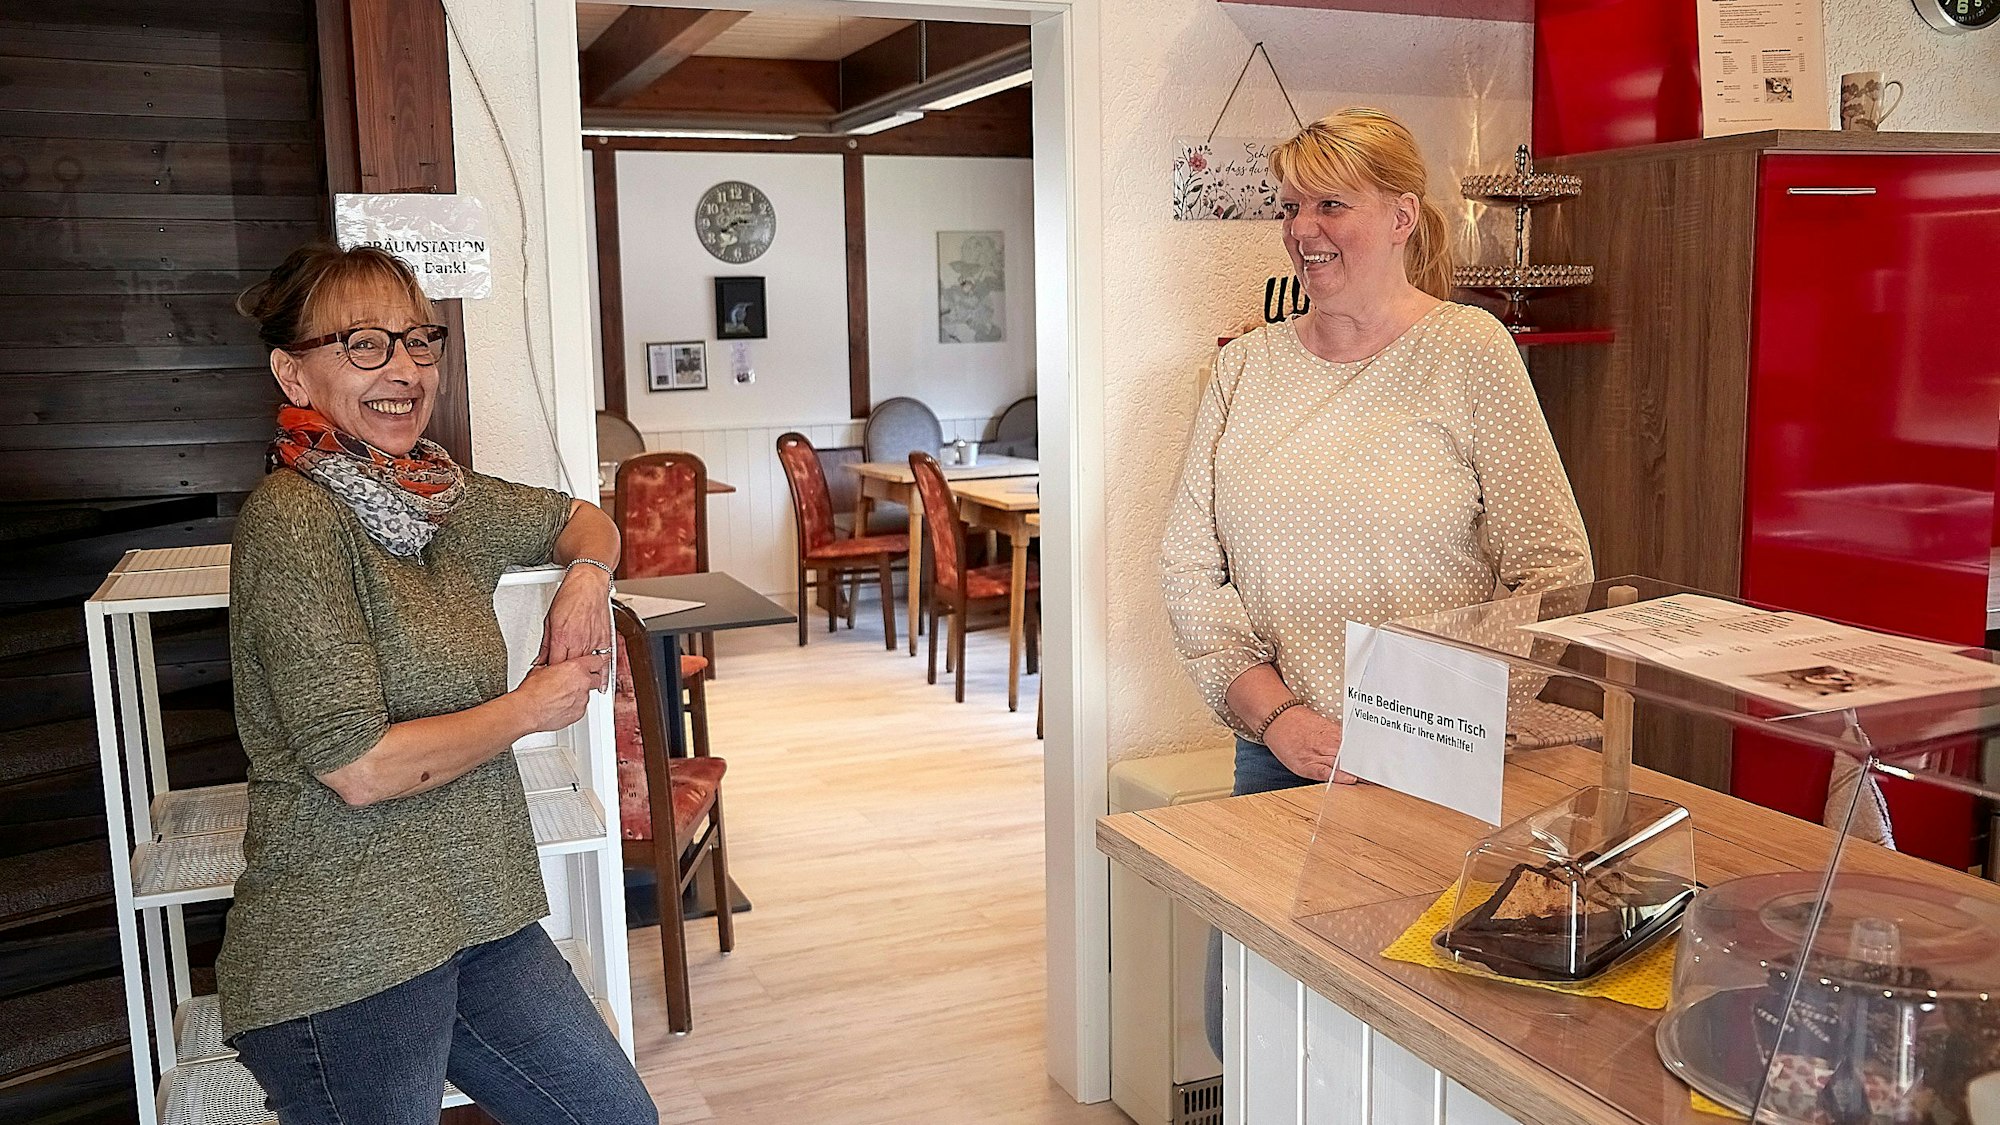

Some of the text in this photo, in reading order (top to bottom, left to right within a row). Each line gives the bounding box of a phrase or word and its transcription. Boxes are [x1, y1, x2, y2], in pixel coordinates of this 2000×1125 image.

[1225, 160, 1245, 176] dass
[357, 238, 485, 253] RÄUMSTATION
[425, 261, 466, 274] Dank!
[1376, 694, 1434, 726] Bedienung
[1437, 715, 1454, 729] am
[1457, 717, 1486, 739] Tisch
[1354, 708, 1474, 753] Vielen Dank für Ihre Mithilfe!
